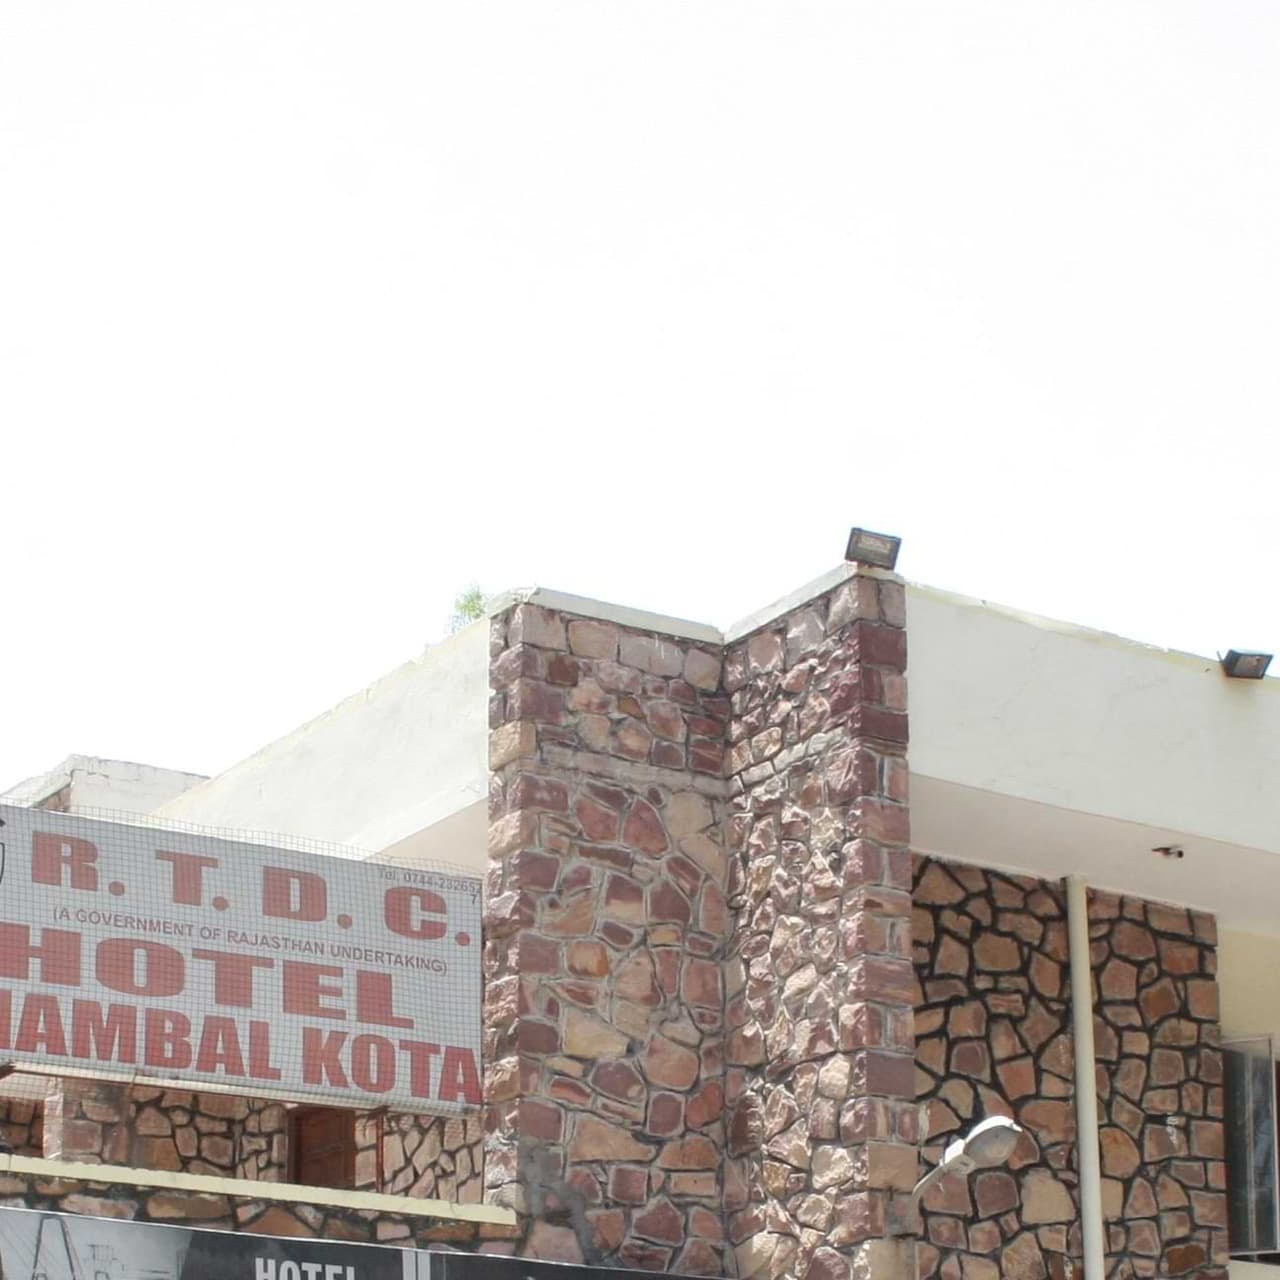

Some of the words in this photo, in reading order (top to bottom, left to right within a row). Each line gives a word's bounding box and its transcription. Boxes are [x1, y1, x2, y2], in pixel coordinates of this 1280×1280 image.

[76, 908, 194, 938] GOVERNMENT
[200, 926, 222, 940] OF
[226, 929, 325, 956] RAJASTHAN
[331, 944, 448, 976] UNDERTAKING)
[303, 1026, 483, 1104] KOTA
